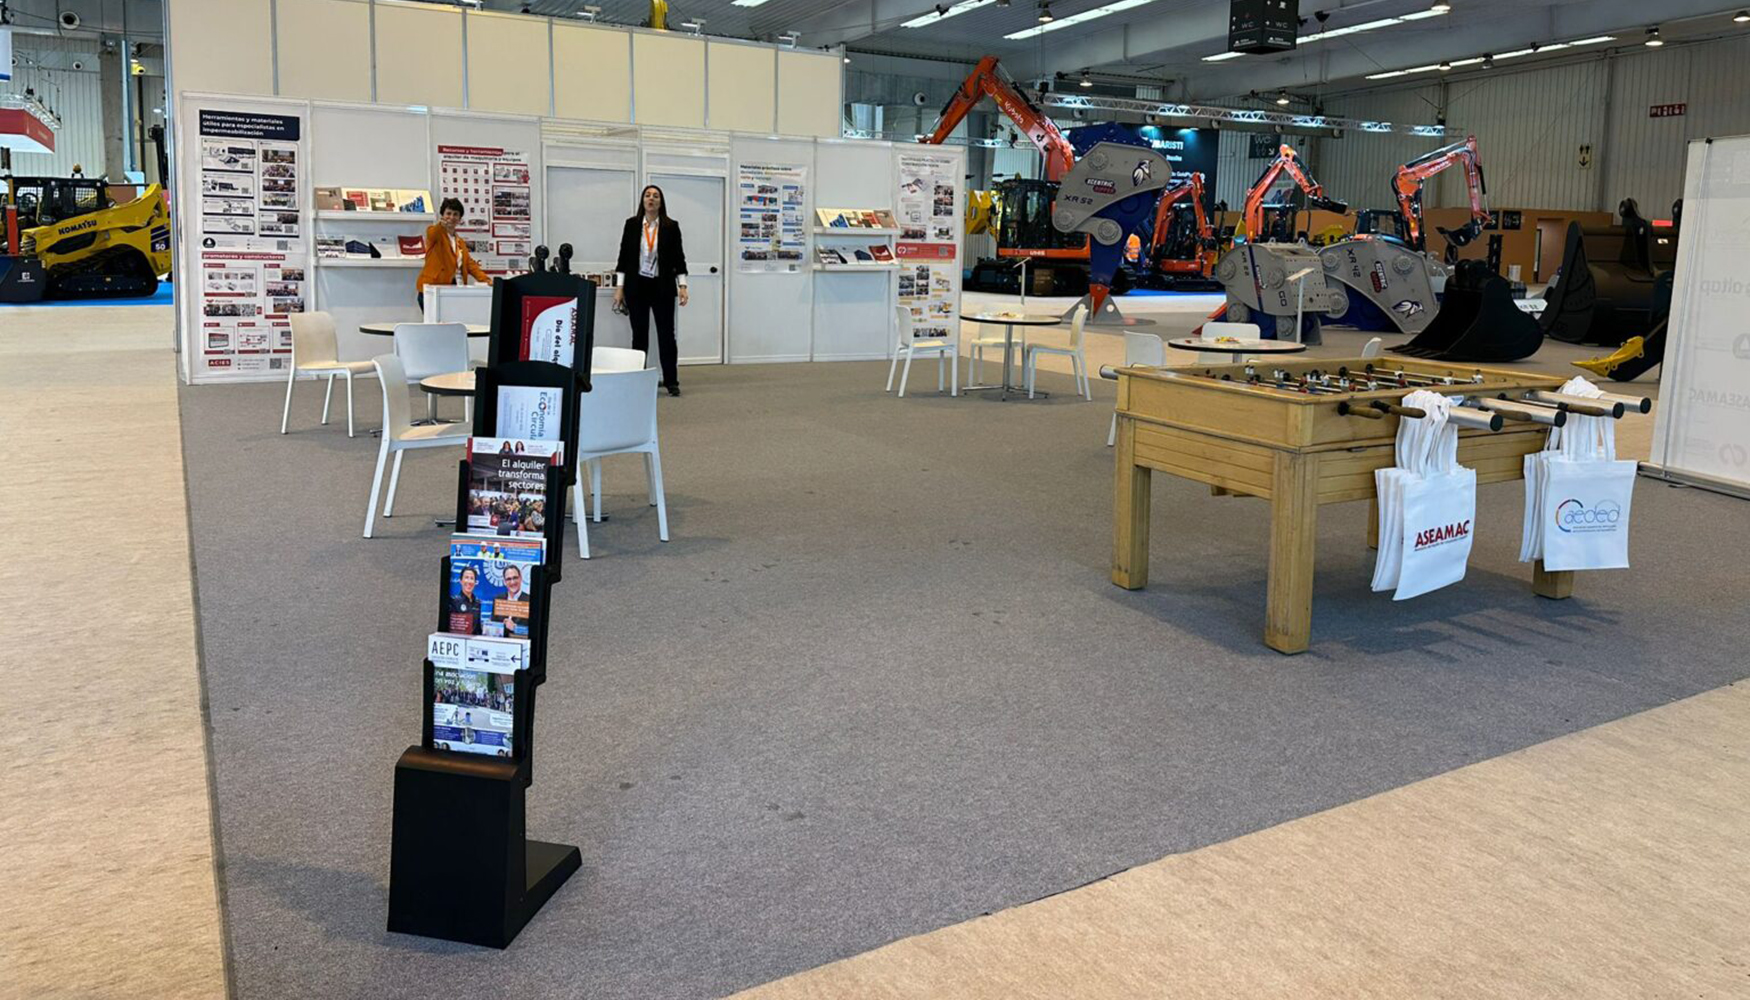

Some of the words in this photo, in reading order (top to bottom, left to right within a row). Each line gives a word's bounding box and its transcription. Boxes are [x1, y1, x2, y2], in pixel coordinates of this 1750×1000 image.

[202, 114, 245, 122] Herramientas
[1254, 134, 1272, 144] WC
[58, 220, 97, 235] KOMATSU
[555, 319, 563, 332] Día
[502, 459, 510, 468] El
[512, 460, 545, 470] alquiler
[498, 470, 544, 480] transforma
[508, 481, 544, 490] sectores
[1414, 519, 1470, 548] ASEAMAC
[432, 641, 459, 656] AEPC
